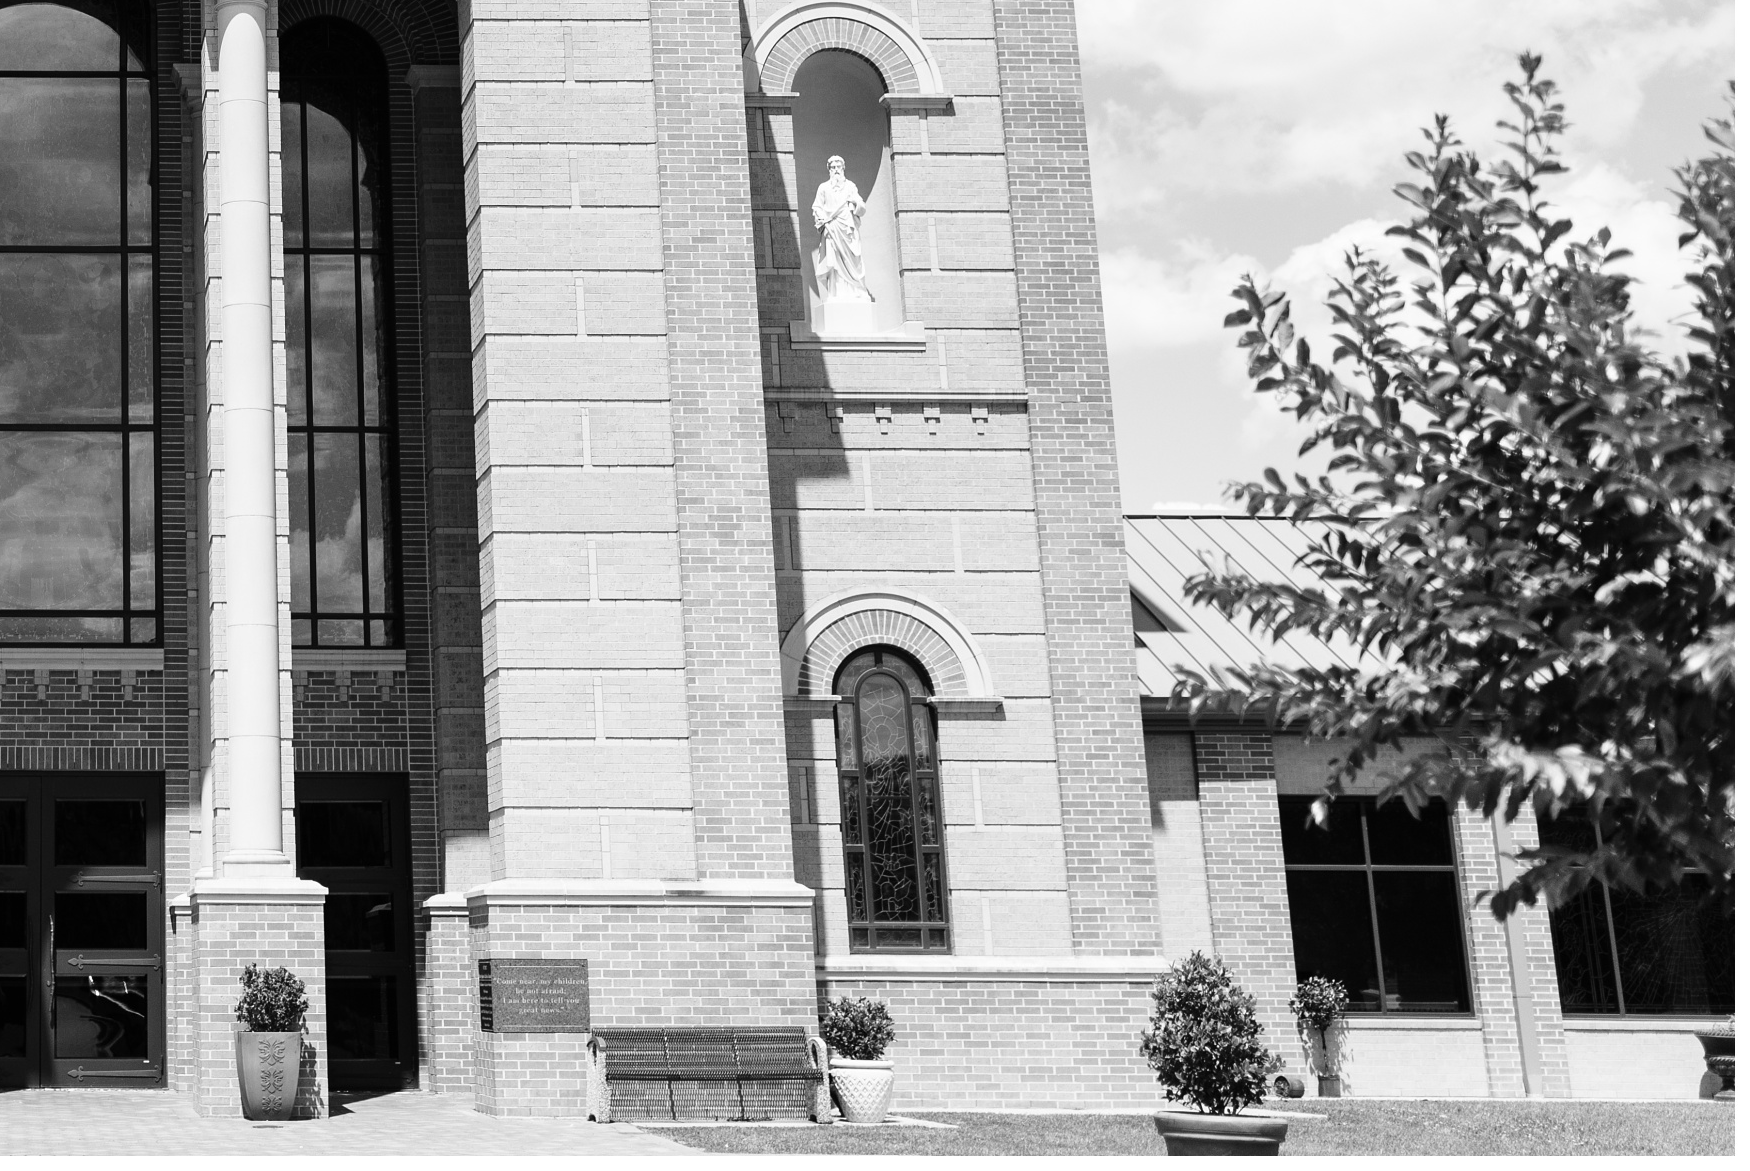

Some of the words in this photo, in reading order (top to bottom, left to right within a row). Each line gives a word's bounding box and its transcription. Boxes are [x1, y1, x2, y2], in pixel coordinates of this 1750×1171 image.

[540, 979, 551, 987] my
[522, 996, 539, 1004] here
[550, 996, 564, 1004] tell
[565, 998, 580, 1007] you
[518, 1007, 538, 1015] great
